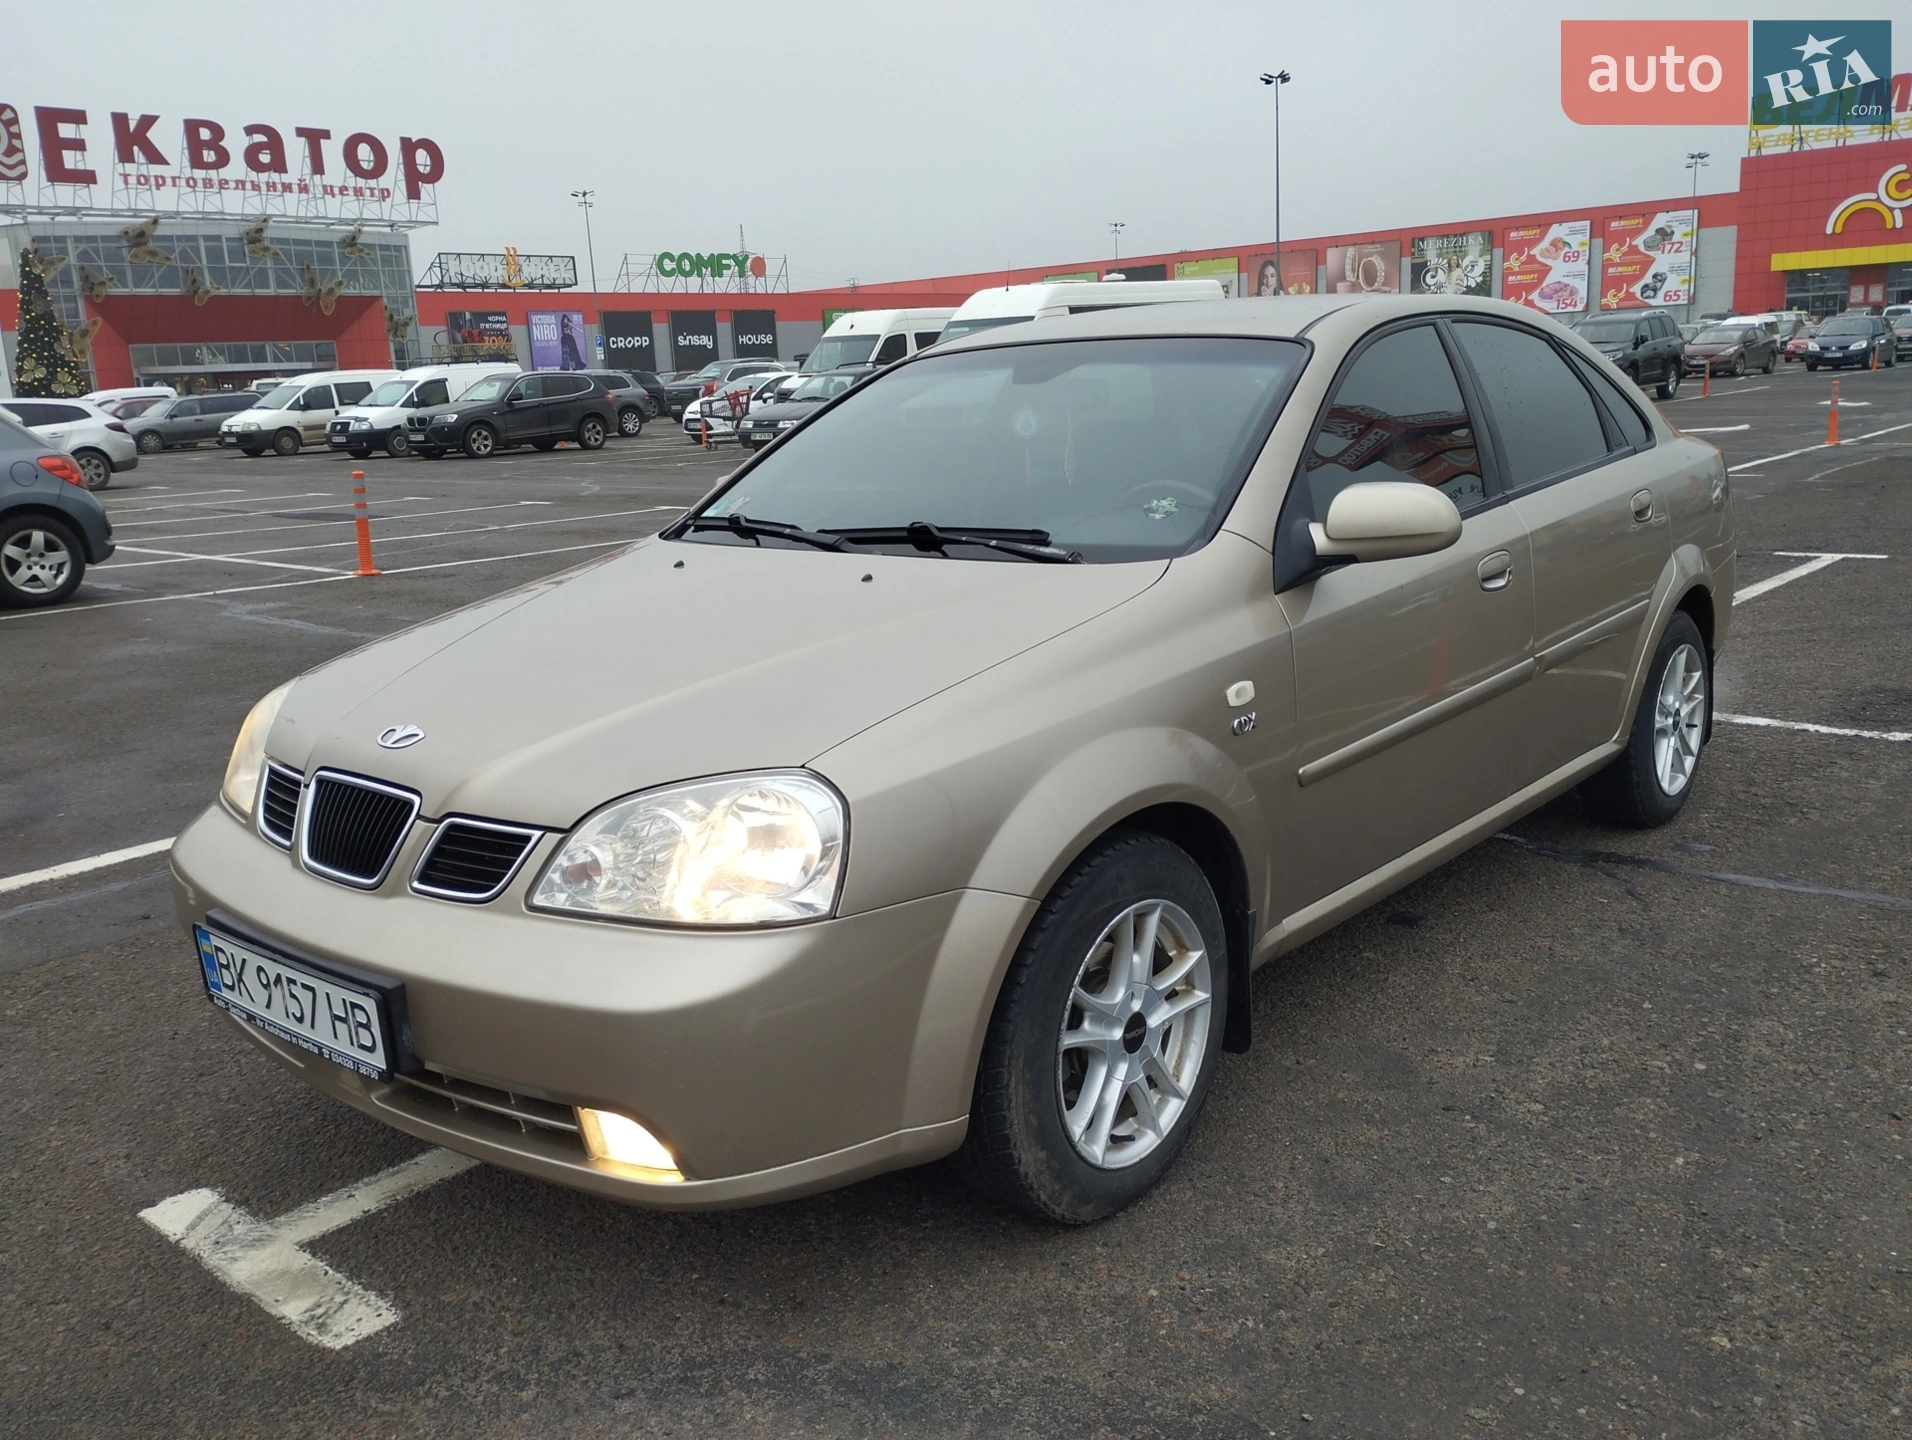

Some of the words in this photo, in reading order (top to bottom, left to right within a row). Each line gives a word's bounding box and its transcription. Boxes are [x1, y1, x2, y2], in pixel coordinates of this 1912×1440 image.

[119, 172, 309, 195] торговельний
[323, 182, 391, 203] центр
[1611, 218, 1643, 228] ВЕЛМАРТ
[1510, 229, 1541, 238] ВЕЛМАРТ
[1418, 235, 1484, 250] MEREZHKA
[1660, 240, 1684, 255] 172
[1562, 250, 1581, 263] 69
[657, 251, 750, 279] COMFY
[1608, 265, 1641, 274] ВЕЛМАРТ
[1663, 289, 1681, 302] 65
[1555, 298, 1578, 310] 154
[532, 324, 558, 341] NIRO
[609, 336, 650, 349] CROPP
[677, 332, 714, 350] sinsay
[213, 944, 257, 1004] BK
[256, 963, 317, 1031] 9157
[325, 991, 377, 1054] HB
